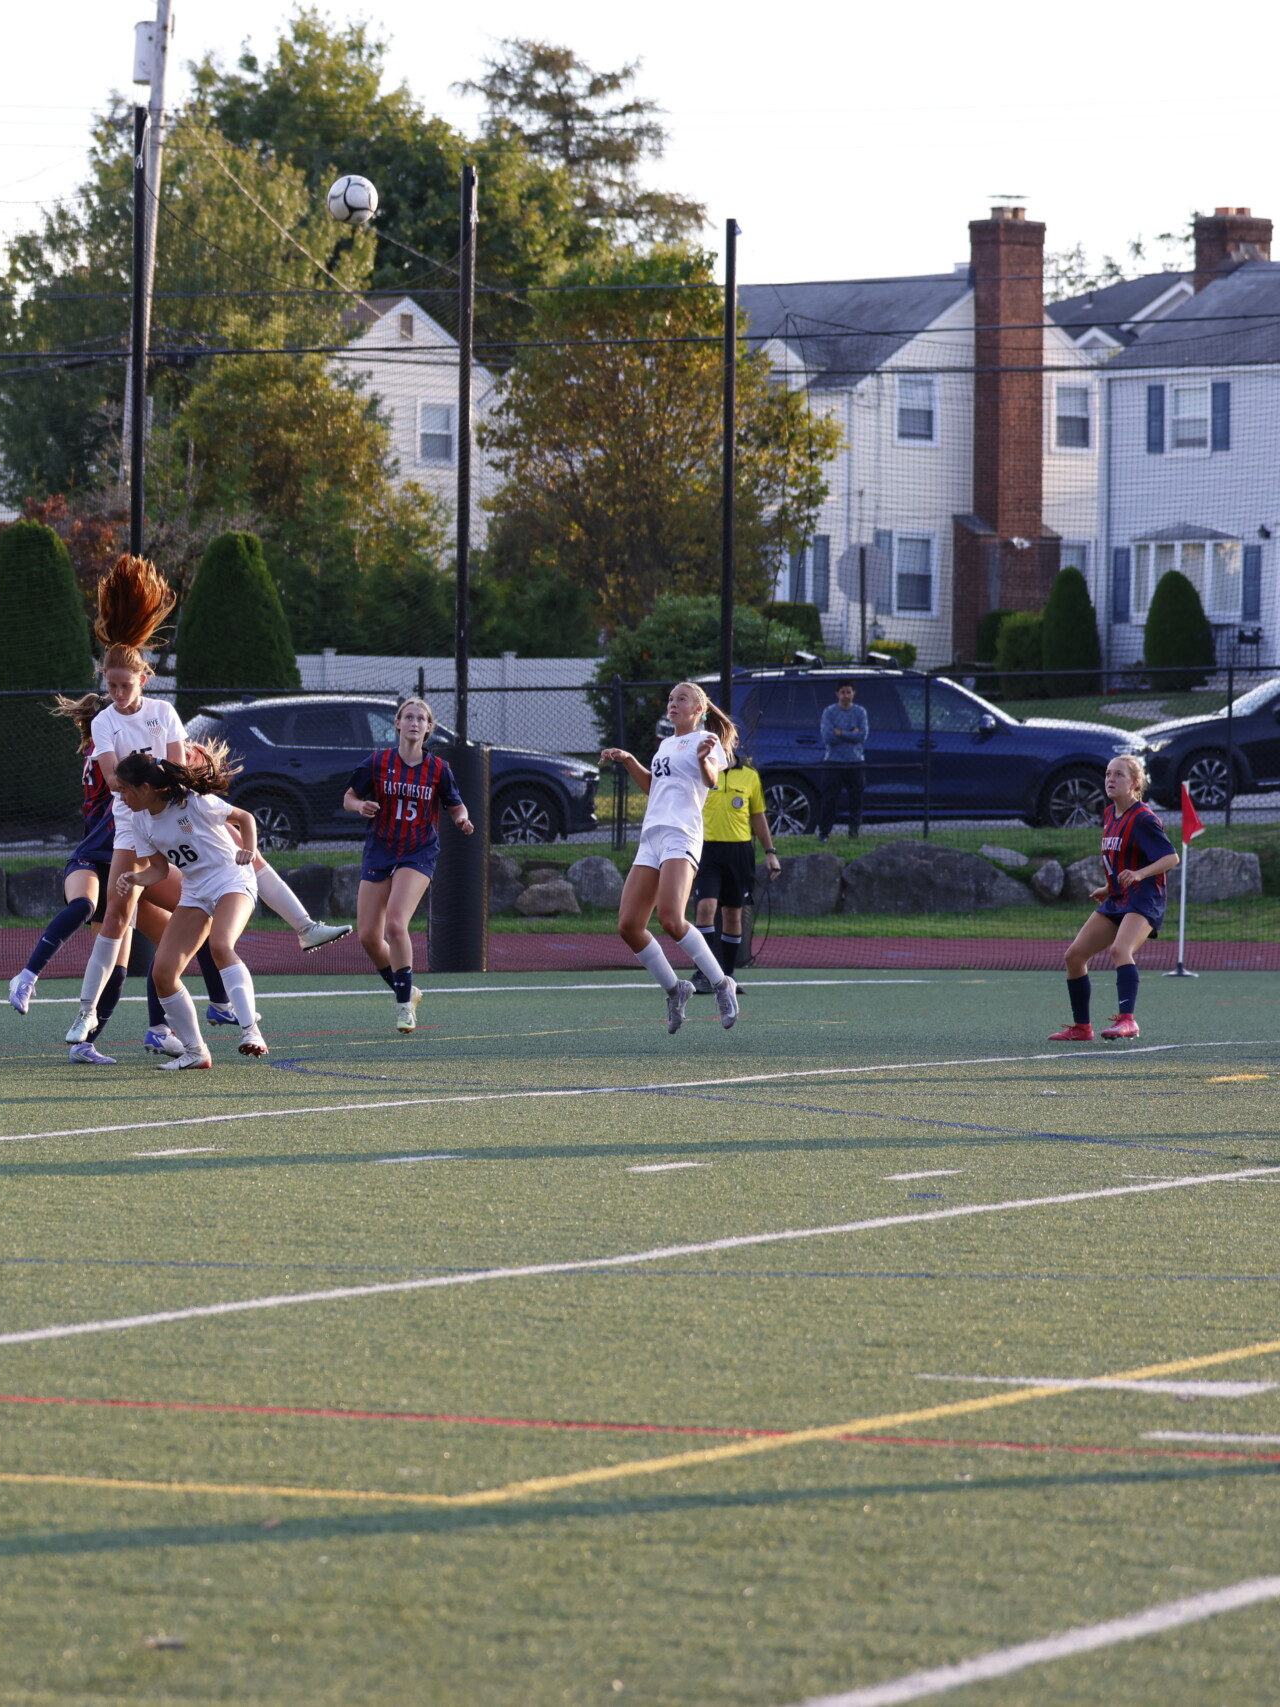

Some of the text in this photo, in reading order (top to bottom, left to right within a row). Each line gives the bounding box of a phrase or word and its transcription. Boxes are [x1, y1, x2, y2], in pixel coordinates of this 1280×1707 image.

[146, 718, 159, 728] RYE
[653, 756, 671, 778] 23
[383, 780, 433, 800] EASTCHESTER
[177, 815, 190, 826] RYE
[395, 799, 418, 821] 15
[167, 844, 199, 868] 26
